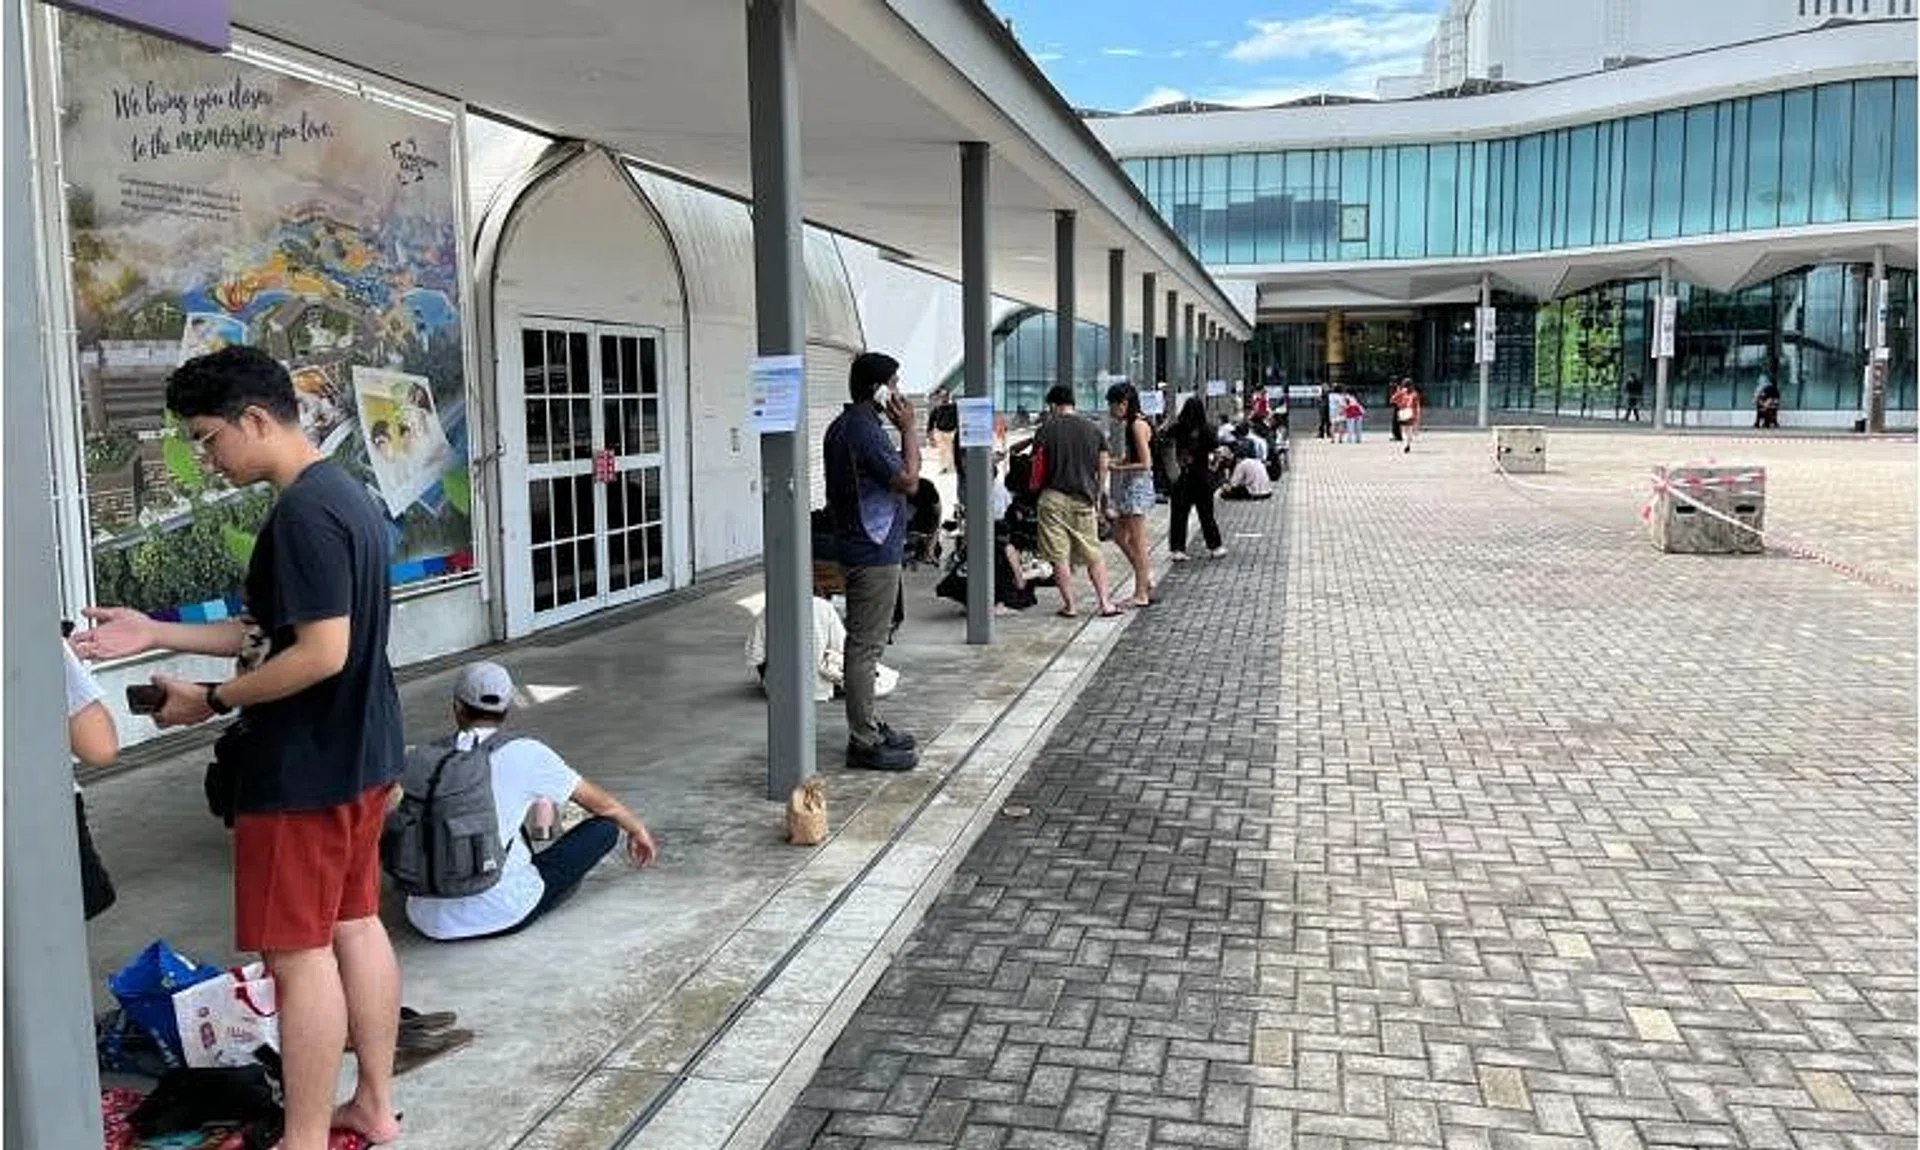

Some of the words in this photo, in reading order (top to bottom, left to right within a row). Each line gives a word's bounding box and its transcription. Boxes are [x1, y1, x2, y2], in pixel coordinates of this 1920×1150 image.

[113, 87, 142, 119] We
[146, 80, 187, 124] bring
[193, 92, 224, 124] you
[131, 134, 148, 162] to
[150, 127, 171, 159] the
[175, 119, 266, 153] memories
[270, 123, 298, 155] you
